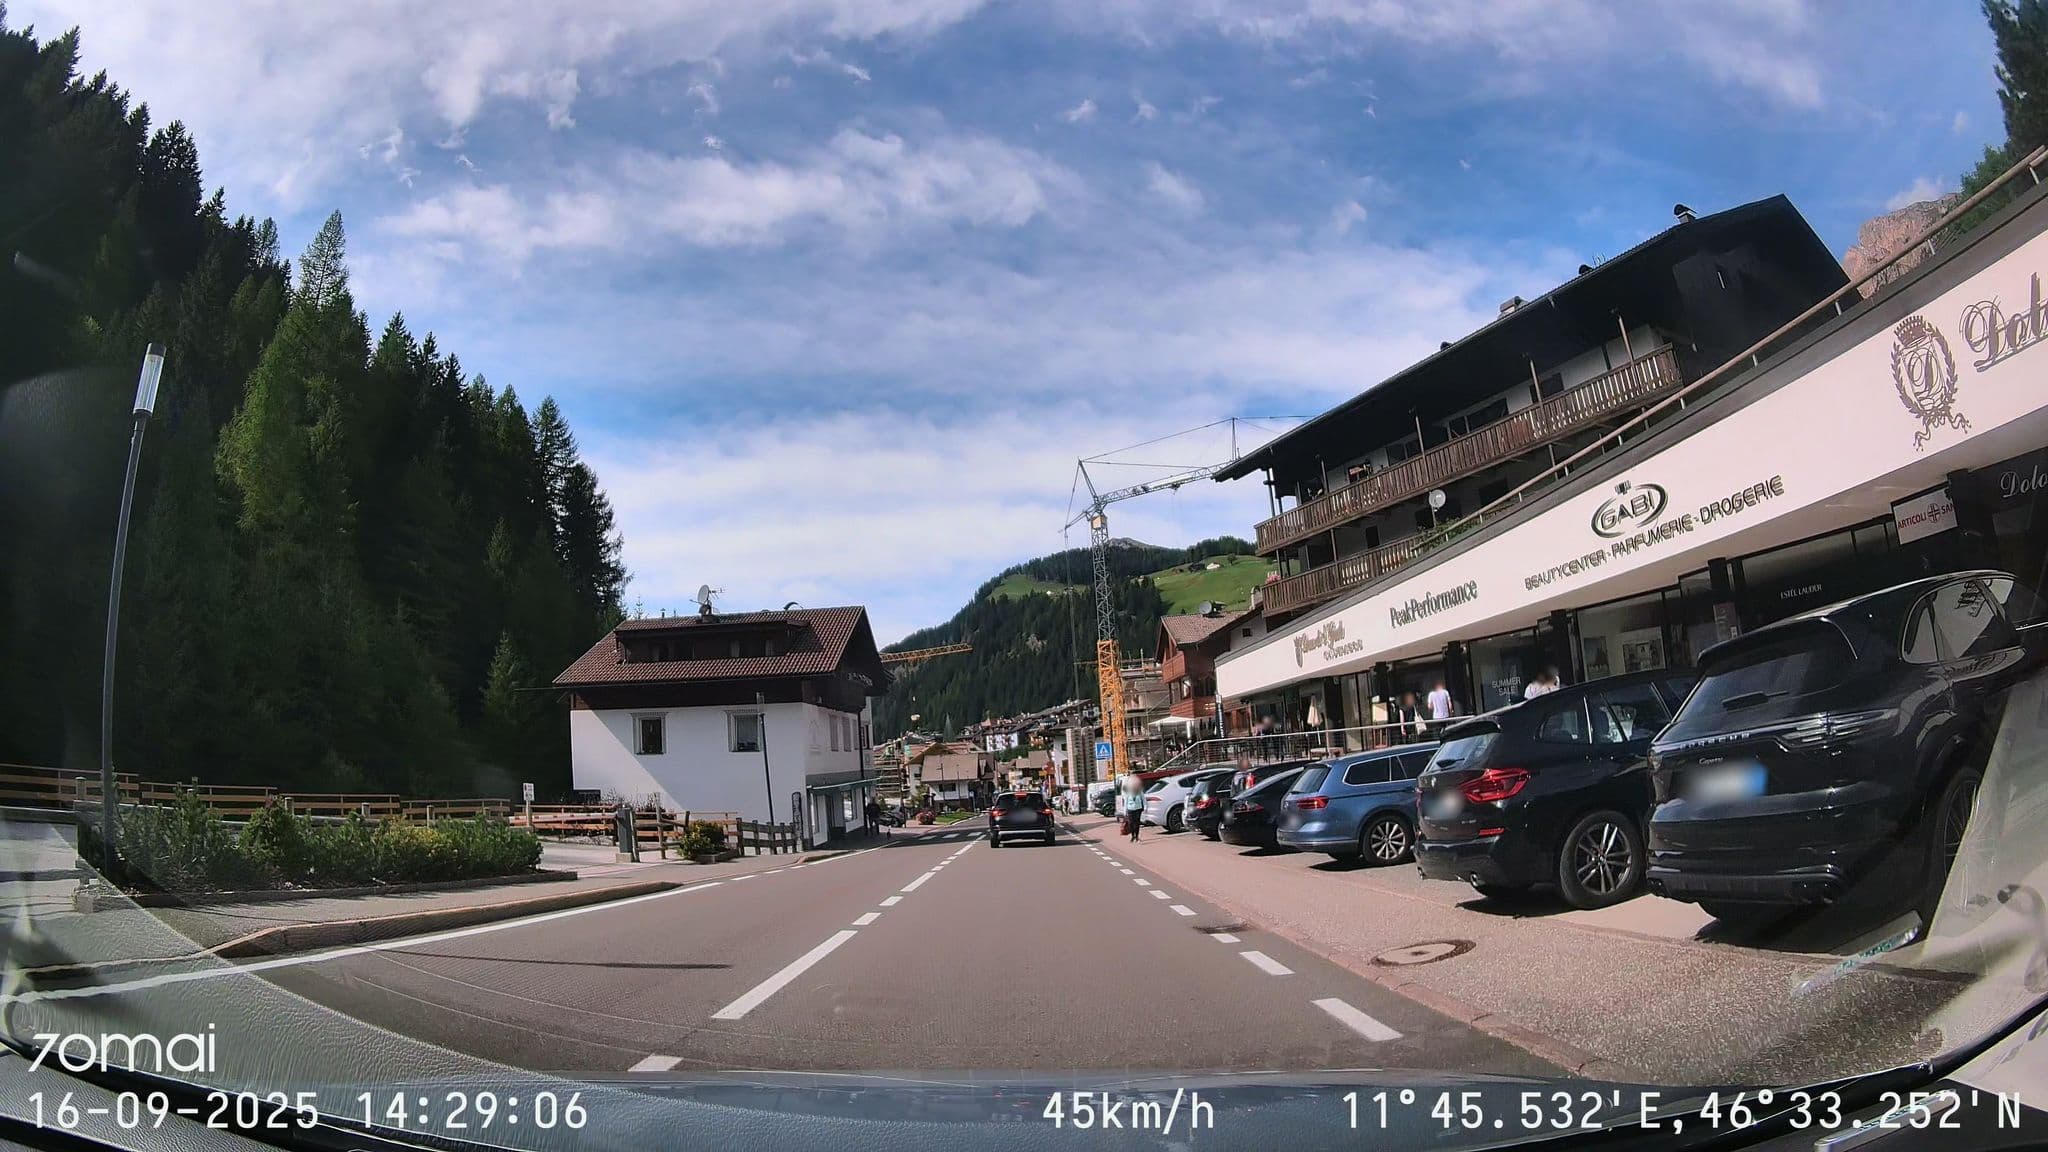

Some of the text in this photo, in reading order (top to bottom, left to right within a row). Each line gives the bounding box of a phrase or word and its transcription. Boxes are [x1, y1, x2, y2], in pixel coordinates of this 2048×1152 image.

[1600, 490, 1656, 532] GABI
[1897, 512, 1927, 529] ARTICOLI
[1524, 549, 1608, 591] BEAUTYCENTER
[1611, 513, 1694, 560] PARFUMERIE
[1699, 474, 1785, 526] DROGERIE
[1491, 676, 1521, 689] SUMMER
